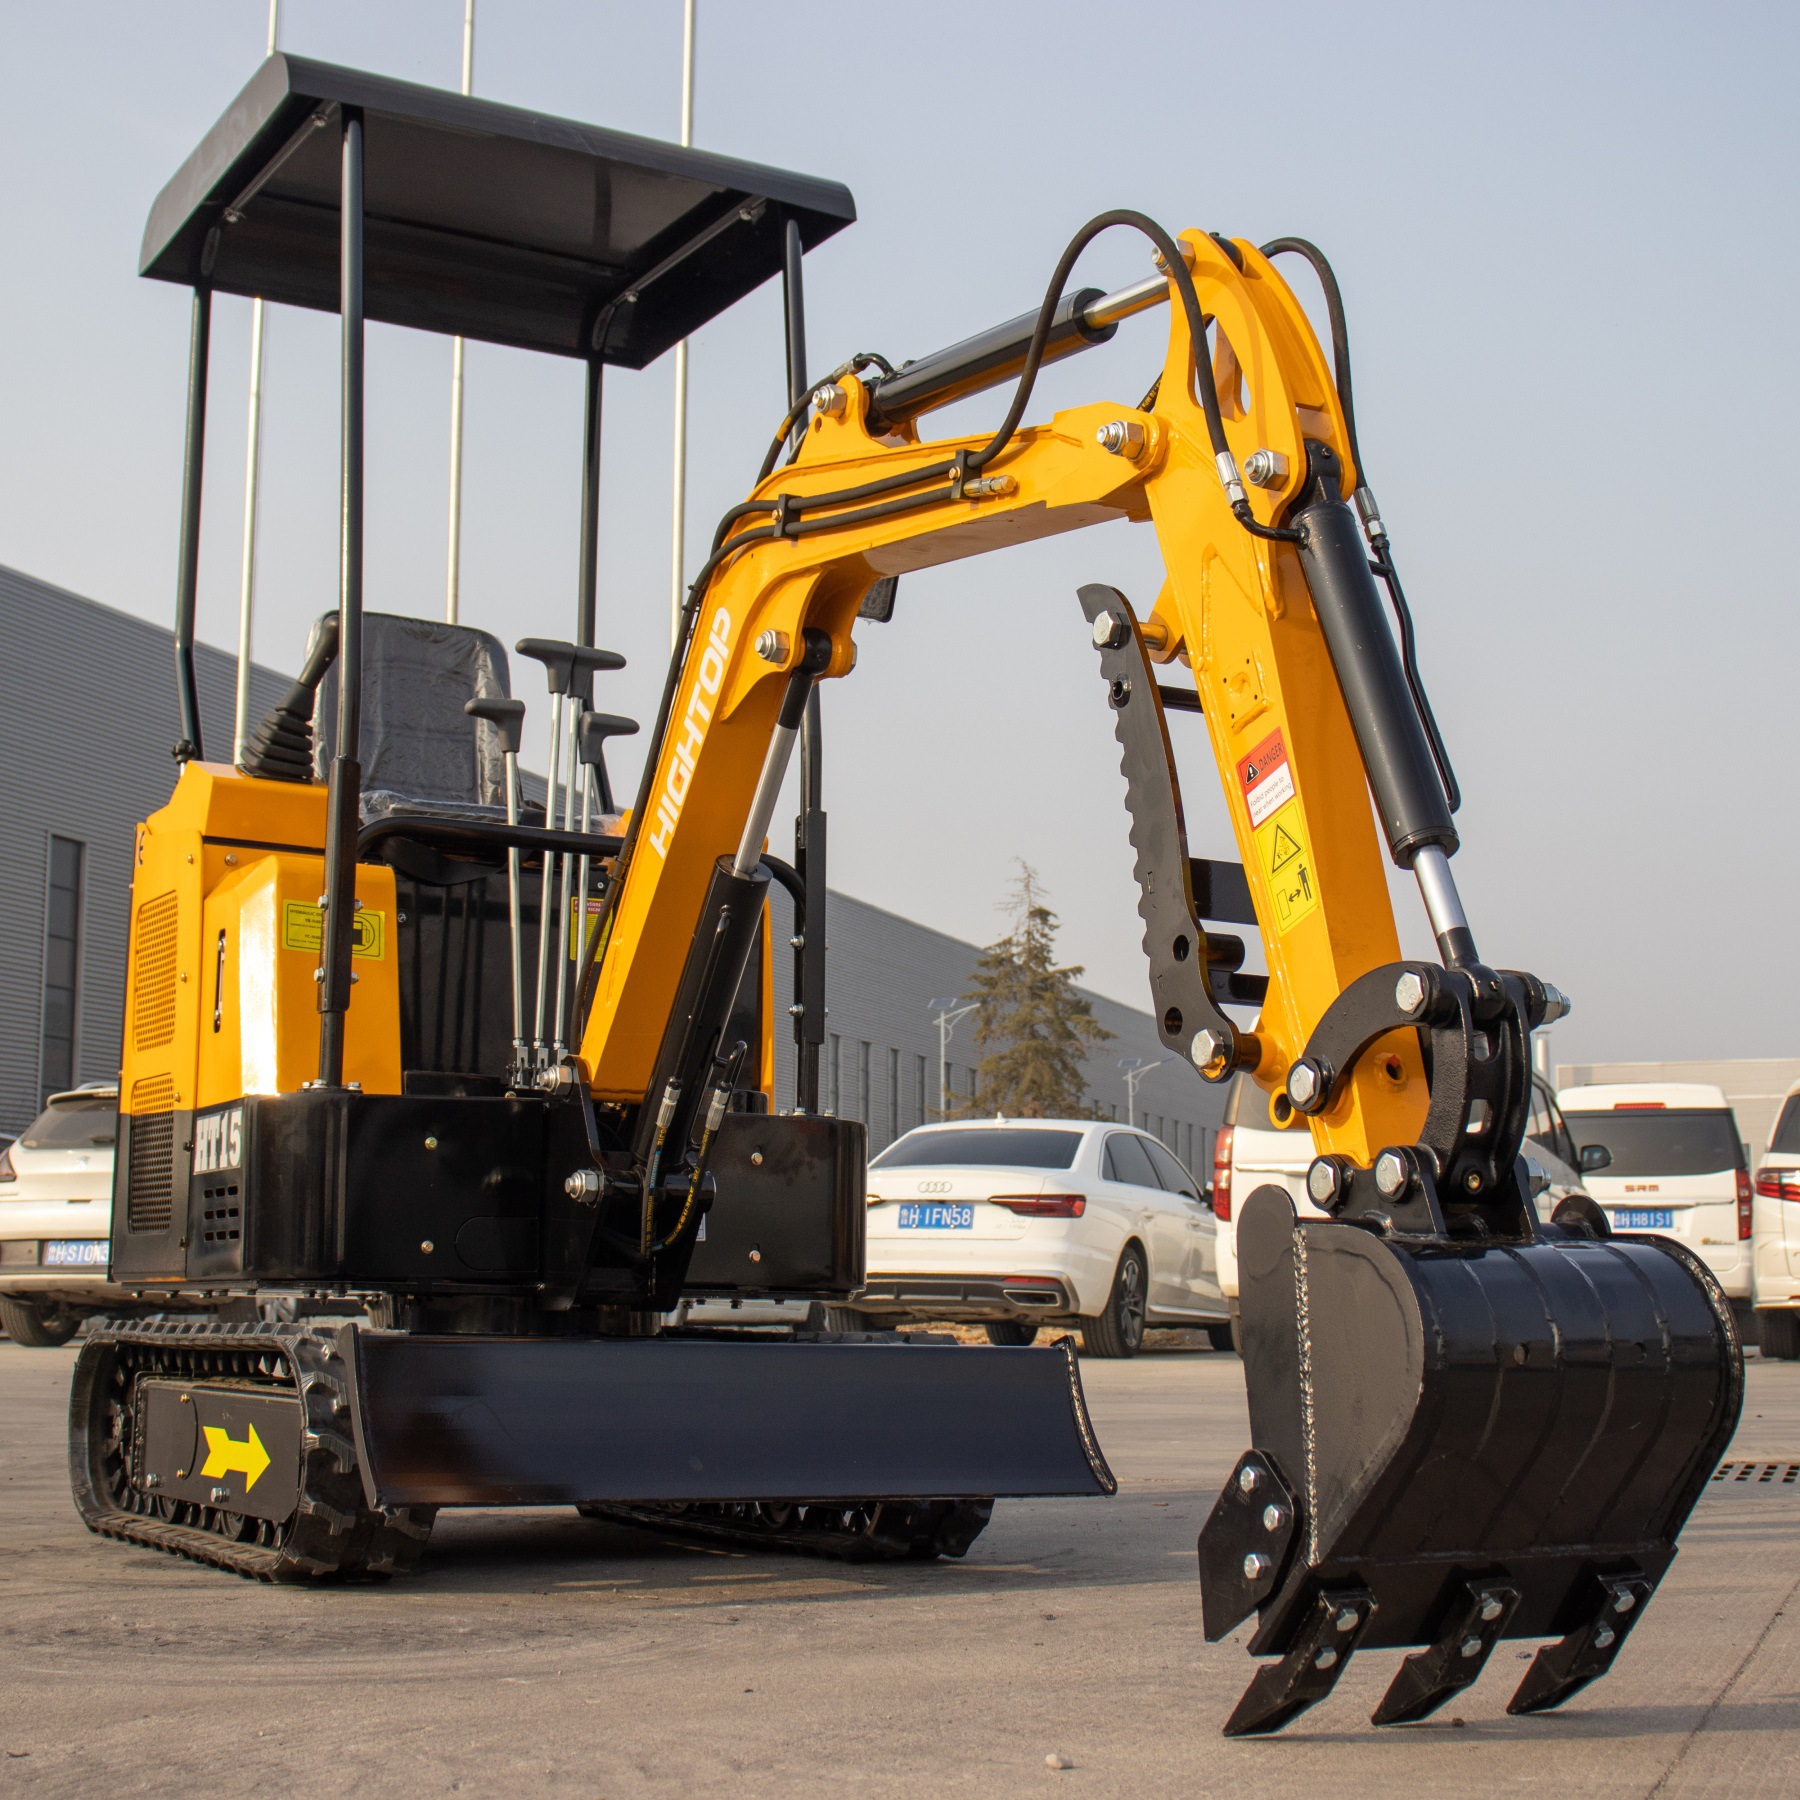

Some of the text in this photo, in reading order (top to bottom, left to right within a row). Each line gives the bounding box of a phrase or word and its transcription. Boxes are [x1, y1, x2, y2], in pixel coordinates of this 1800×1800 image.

[649, 606, 731, 859] HIGHTOP
[1258, 742, 1284, 771] DANGER
[1250, 776, 1285, 807] Forbid people to
[1263, 798, 1275, 811] when
[1274, 783, 1292, 801] working
[289, 908, 315, 916] HYDRAULIC
[194, 1110, 242, 1173] HT15
[1625, 1184, 1659, 1192] SRM
